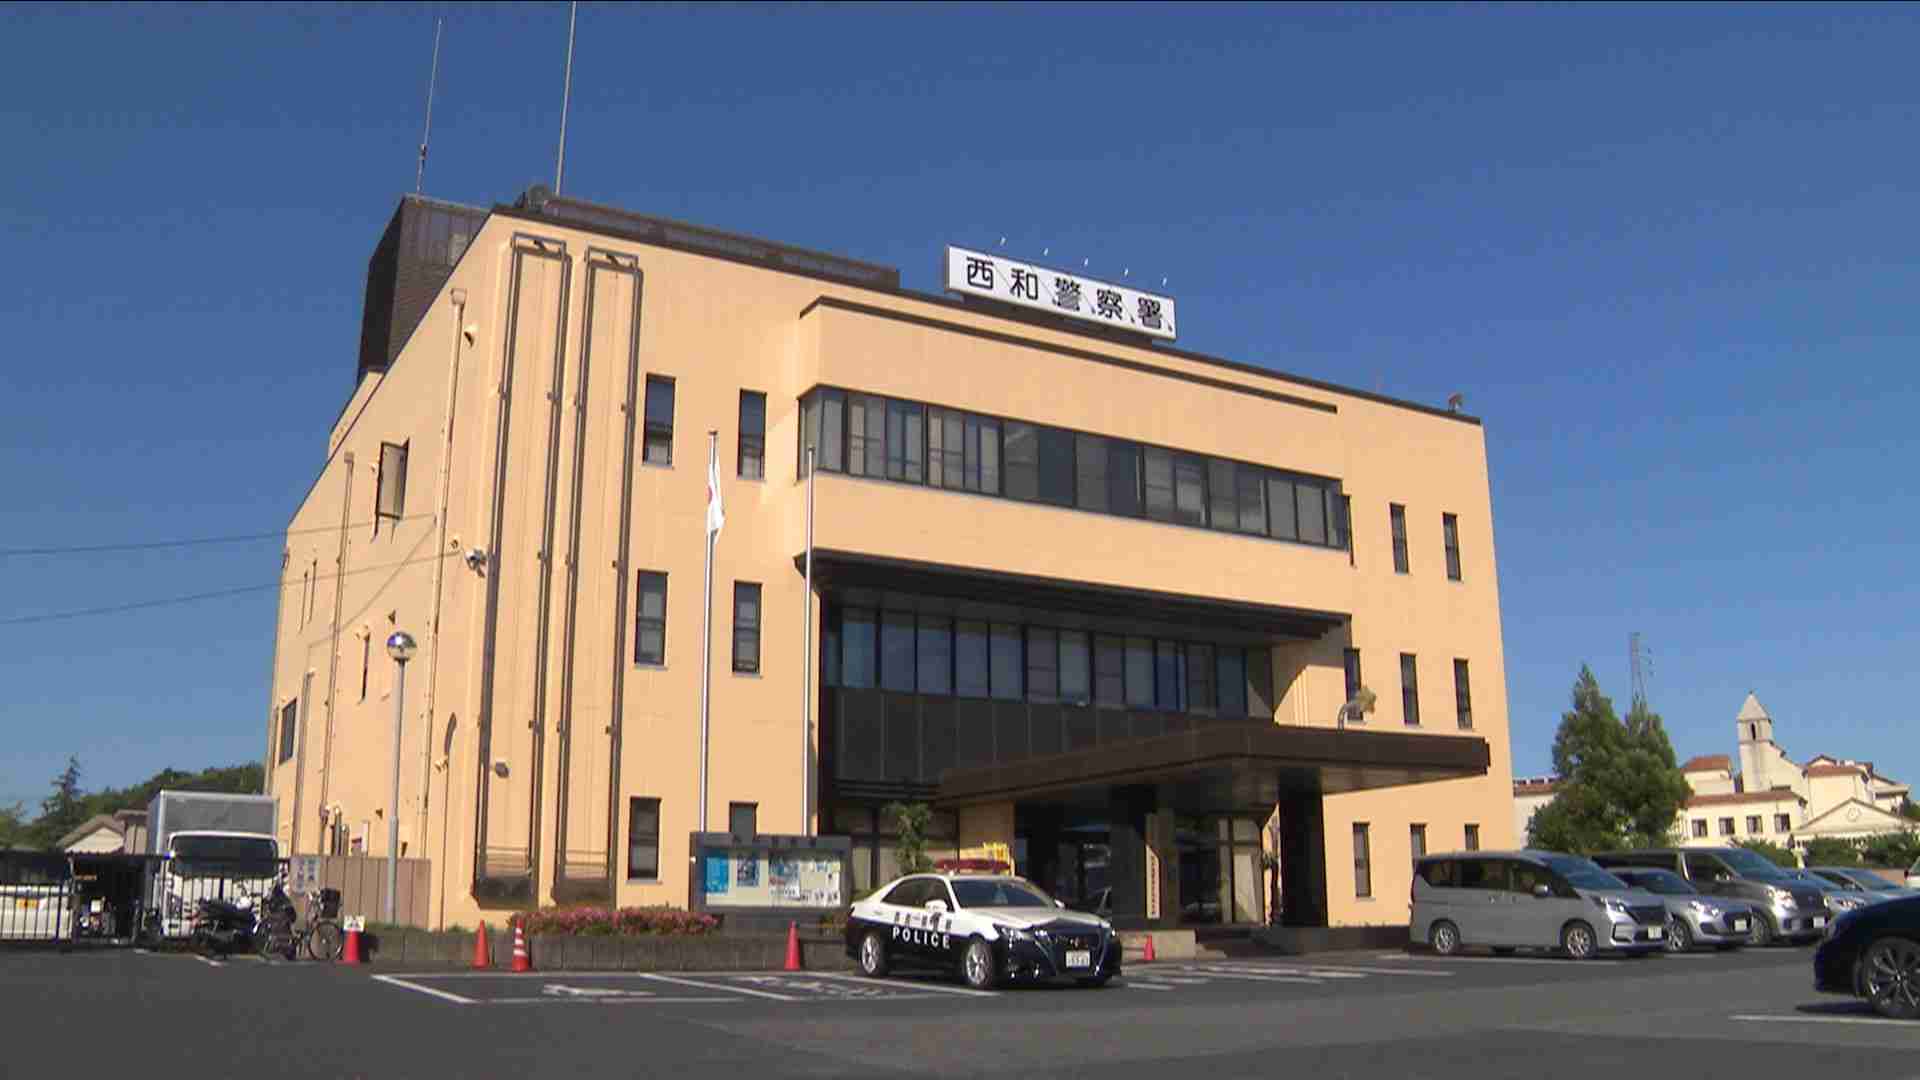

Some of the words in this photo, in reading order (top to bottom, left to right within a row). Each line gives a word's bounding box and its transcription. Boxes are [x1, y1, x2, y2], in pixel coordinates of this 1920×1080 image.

[966, 257, 1163, 330] 西和警察署
[892, 926, 951, 950] POLICE
